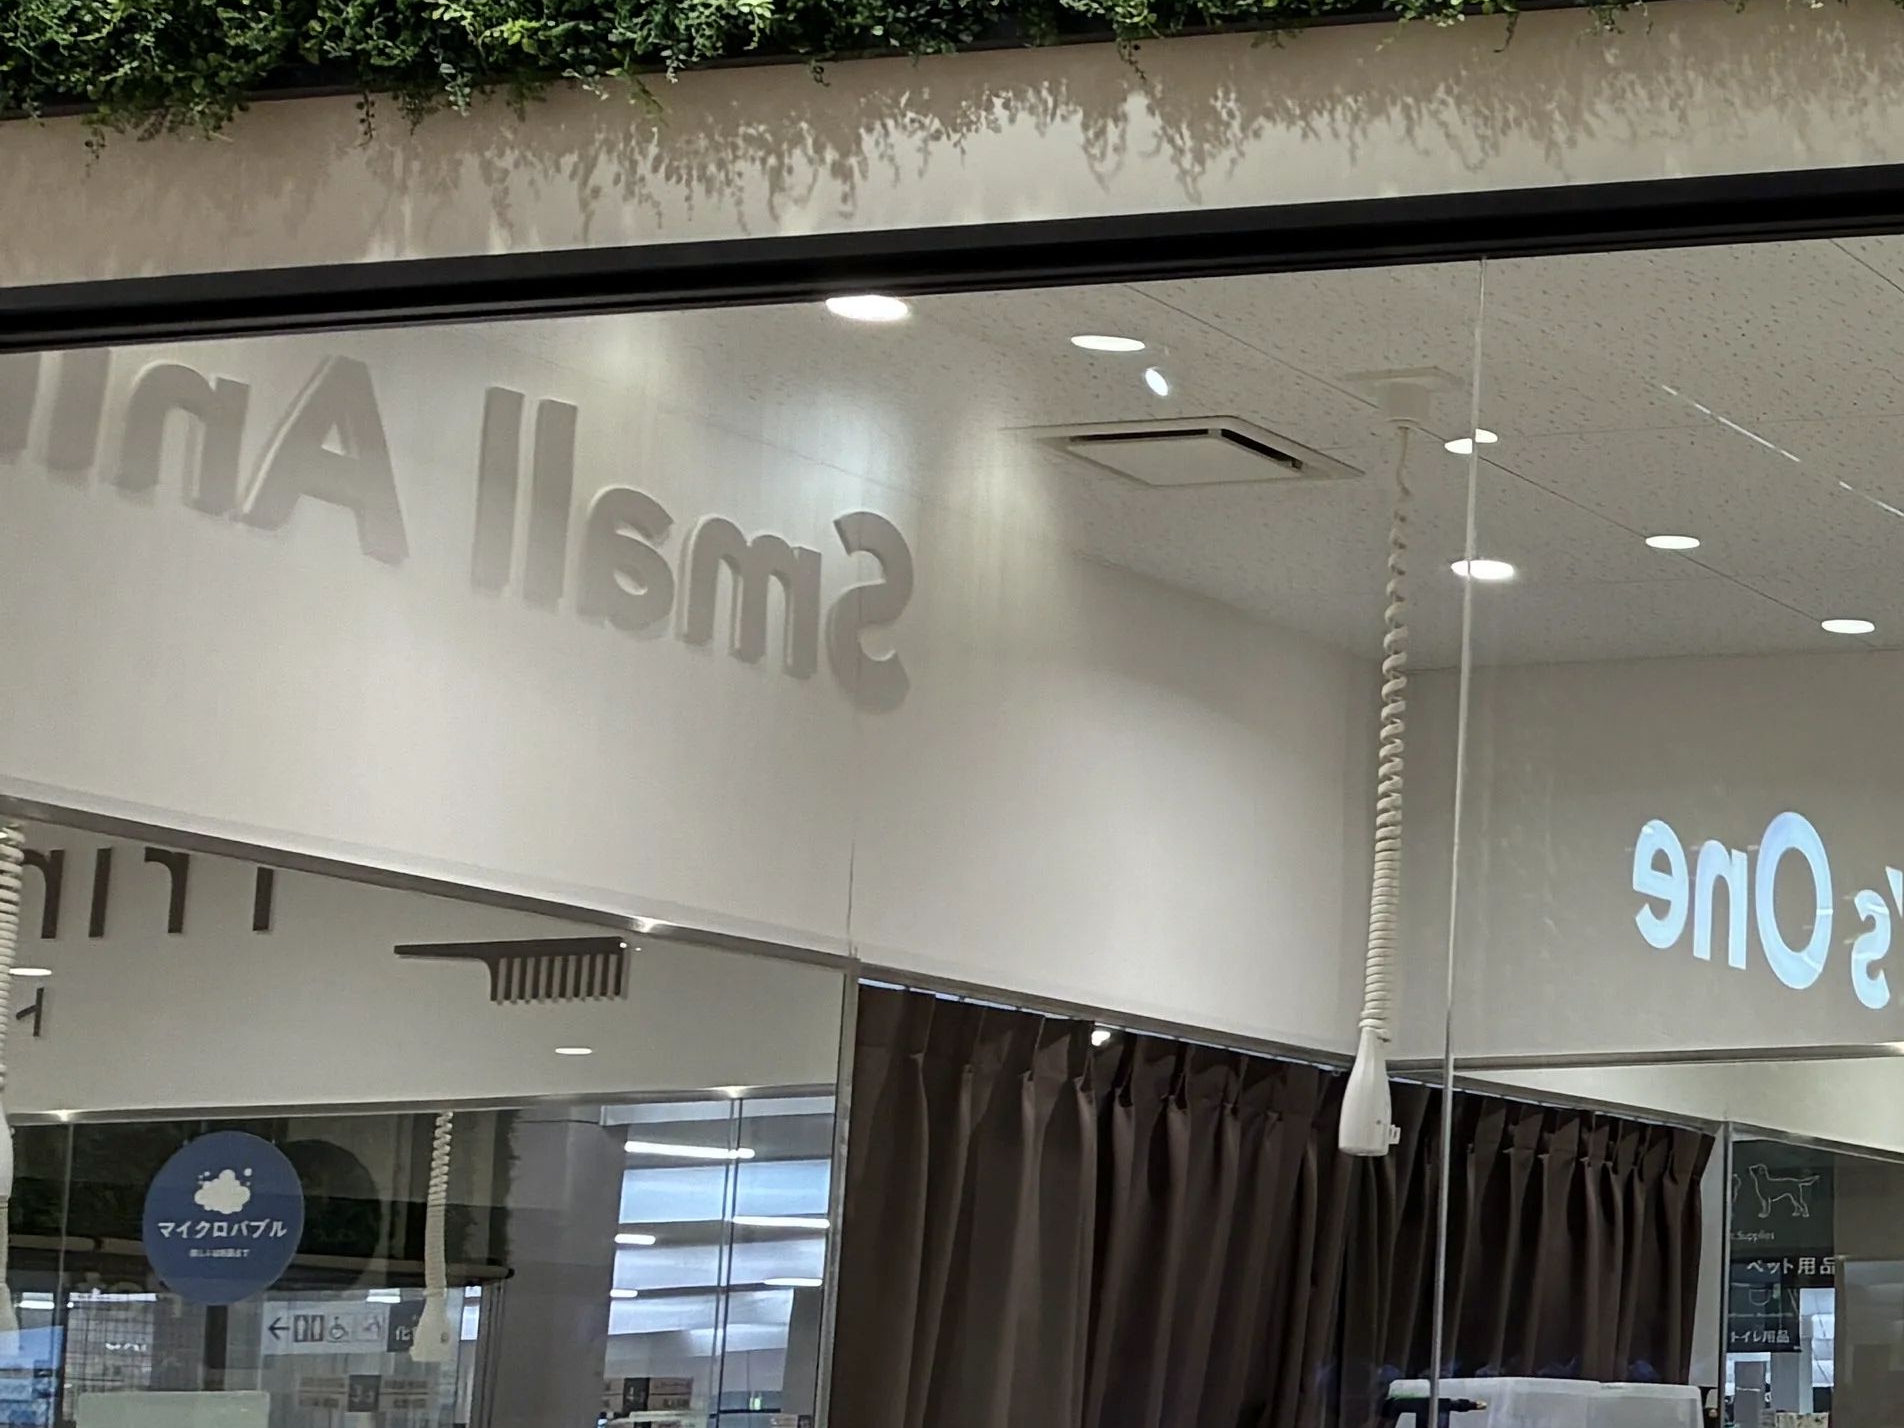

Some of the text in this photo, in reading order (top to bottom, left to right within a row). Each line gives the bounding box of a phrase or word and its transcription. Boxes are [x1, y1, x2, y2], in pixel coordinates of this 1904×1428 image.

[158, 1218, 288, 1239] マイクロバブル
[1747, 1257, 1835, 1275] ペット用品
